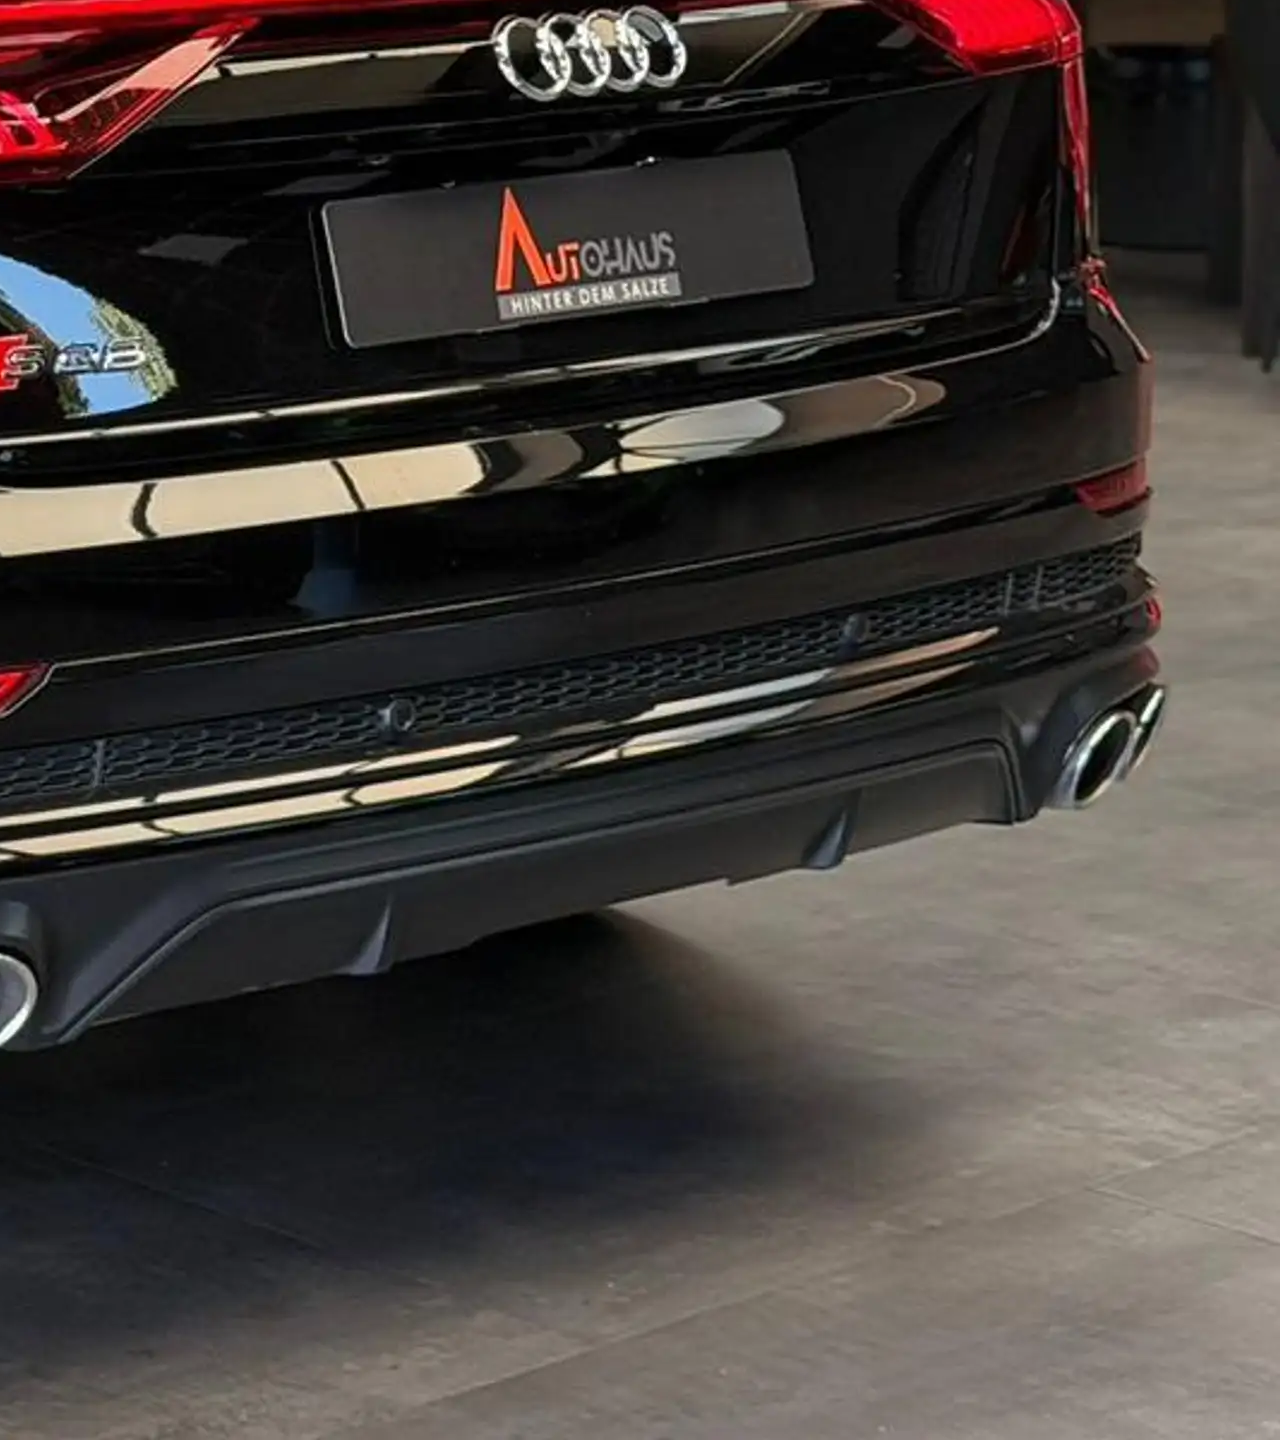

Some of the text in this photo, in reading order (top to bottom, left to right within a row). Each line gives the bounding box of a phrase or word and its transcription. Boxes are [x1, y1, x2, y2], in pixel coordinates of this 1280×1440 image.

[509, 278, 671, 314] HINTER DEM SALZE
